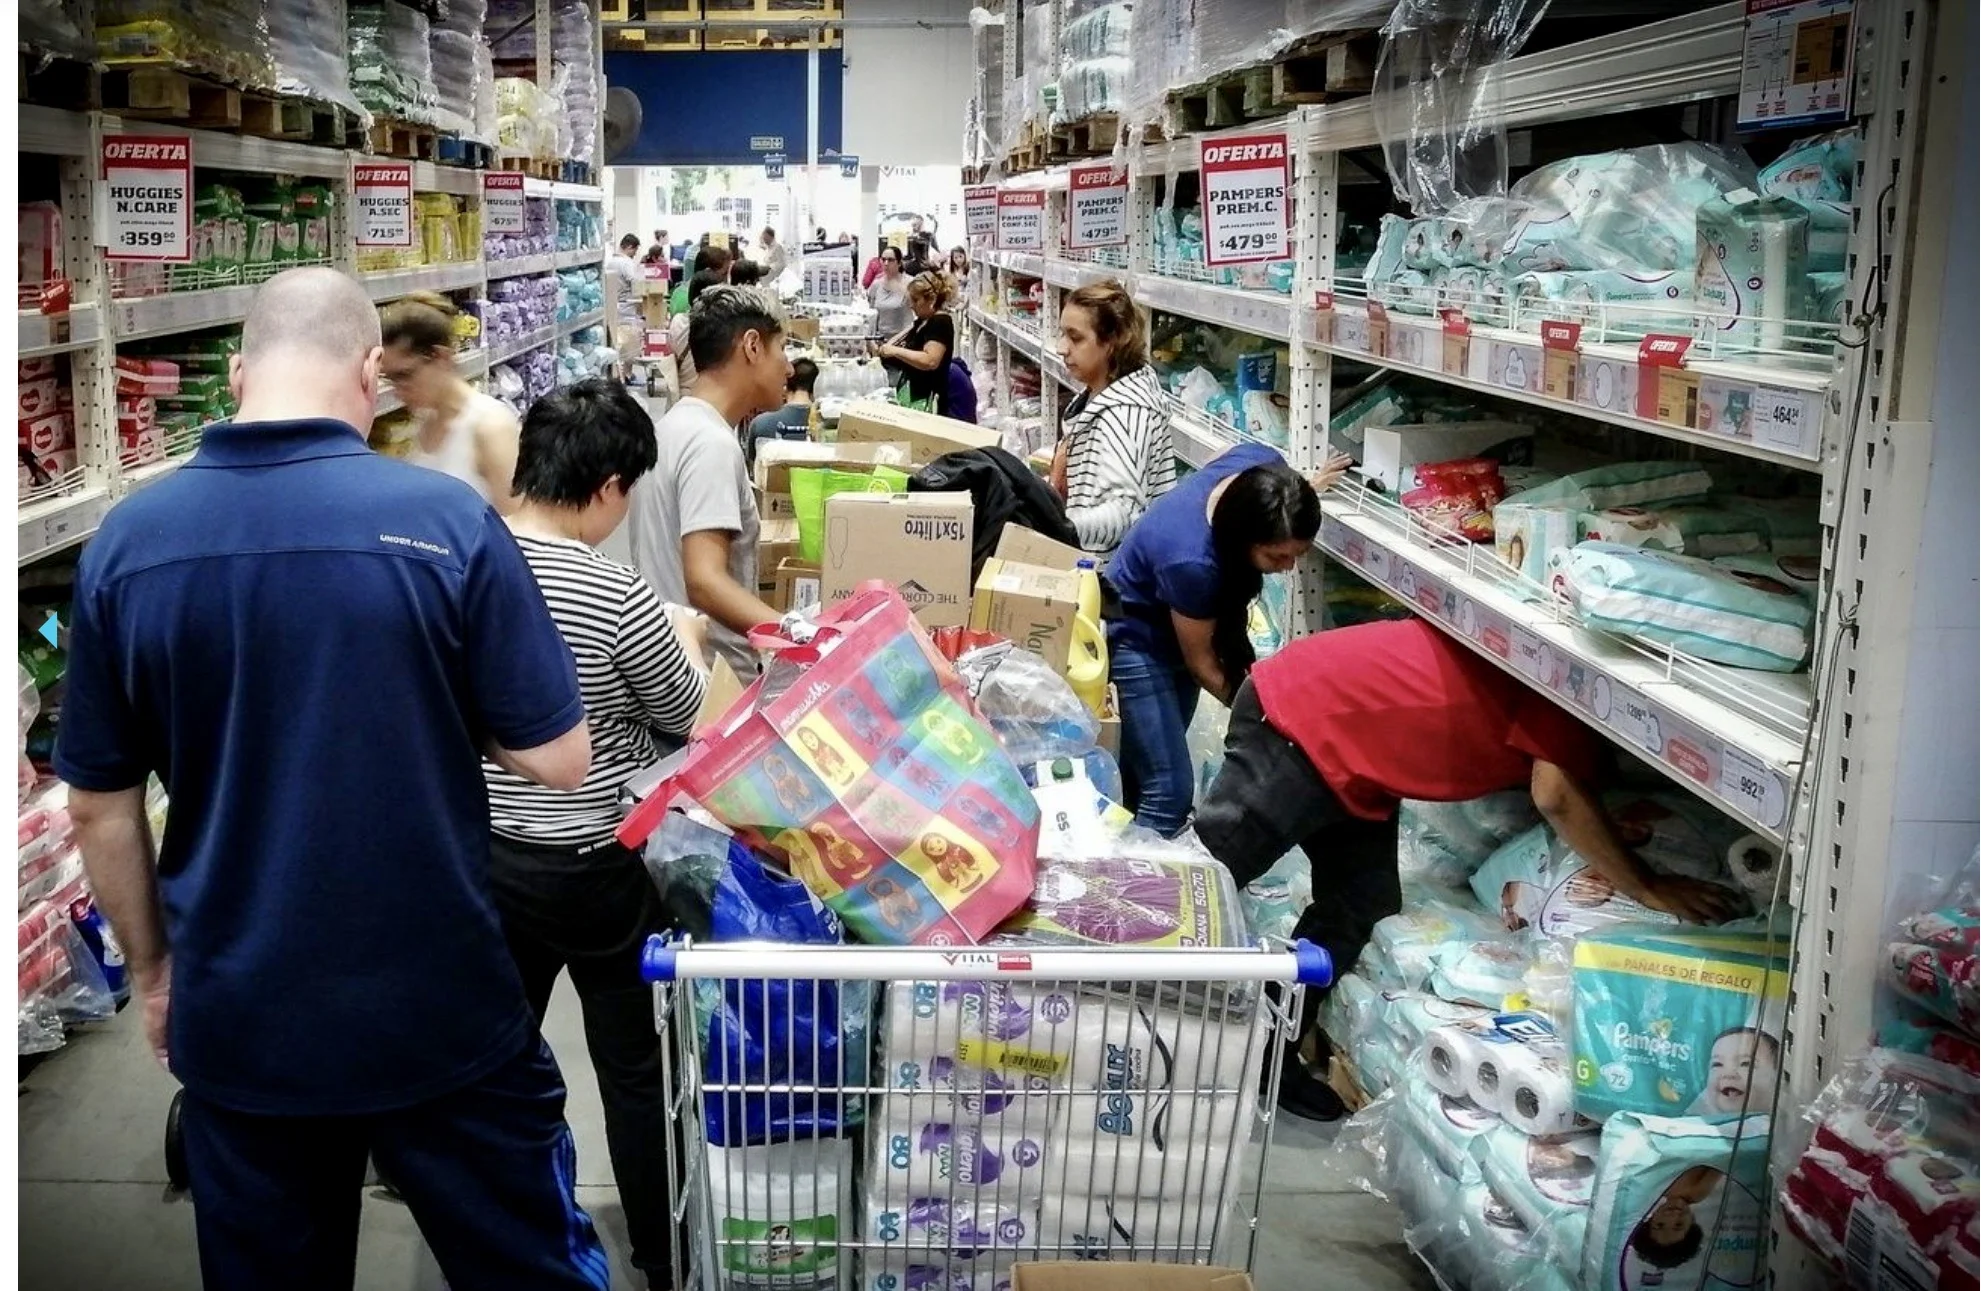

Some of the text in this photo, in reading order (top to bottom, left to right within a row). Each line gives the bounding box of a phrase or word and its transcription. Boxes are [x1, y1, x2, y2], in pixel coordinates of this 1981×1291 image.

[105, 143, 187, 160] OFERTA
[1204, 142, 1285, 163] OFERTA
[356, 170, 408, 181] OFERTA
[487, 177, 521, 187] OFERTA
[1078, 171, 1120, 185] OFERT
[110, 187, 183, 199] HUGGIES
[1003, 193, 1038, 204] OFERTA
[1209, 186, 1284, 202] PAMPERS
[116, 201, 178, 214] N.CARE
[359, 197, 409, 207] HUGGIES
[486, 199, 524, 207] HUGGIES
[1076, 196, 1124, 209] PAMPERS
[1216, 201, 1278, 216] PREM.C.
[369, 207, 401, 217] A.SEC
[1001, 214, 1038, 222] PAMPERS
[1081, 206, 1119, 217] PREM.C.
[904, 520, 965, 541] 15x1 litro
[380, 533, 449, 556] UNDER ARMOUR
[936, 593, 958, 604] THE
[940, 952, 994, 966] VITAL
[1623, 957, 1676, 977] PAÑALES
[1680, 967, 1697, 981] DE
[1700, 970, 1751, 988] REGALO
[1612, 1022, 1691, 1061] Pampers
[1576, 1060, 1589, 1080] G
[1611, 1072, 1626, 1087] 72
[891, 1134, 912, 1170] 80
